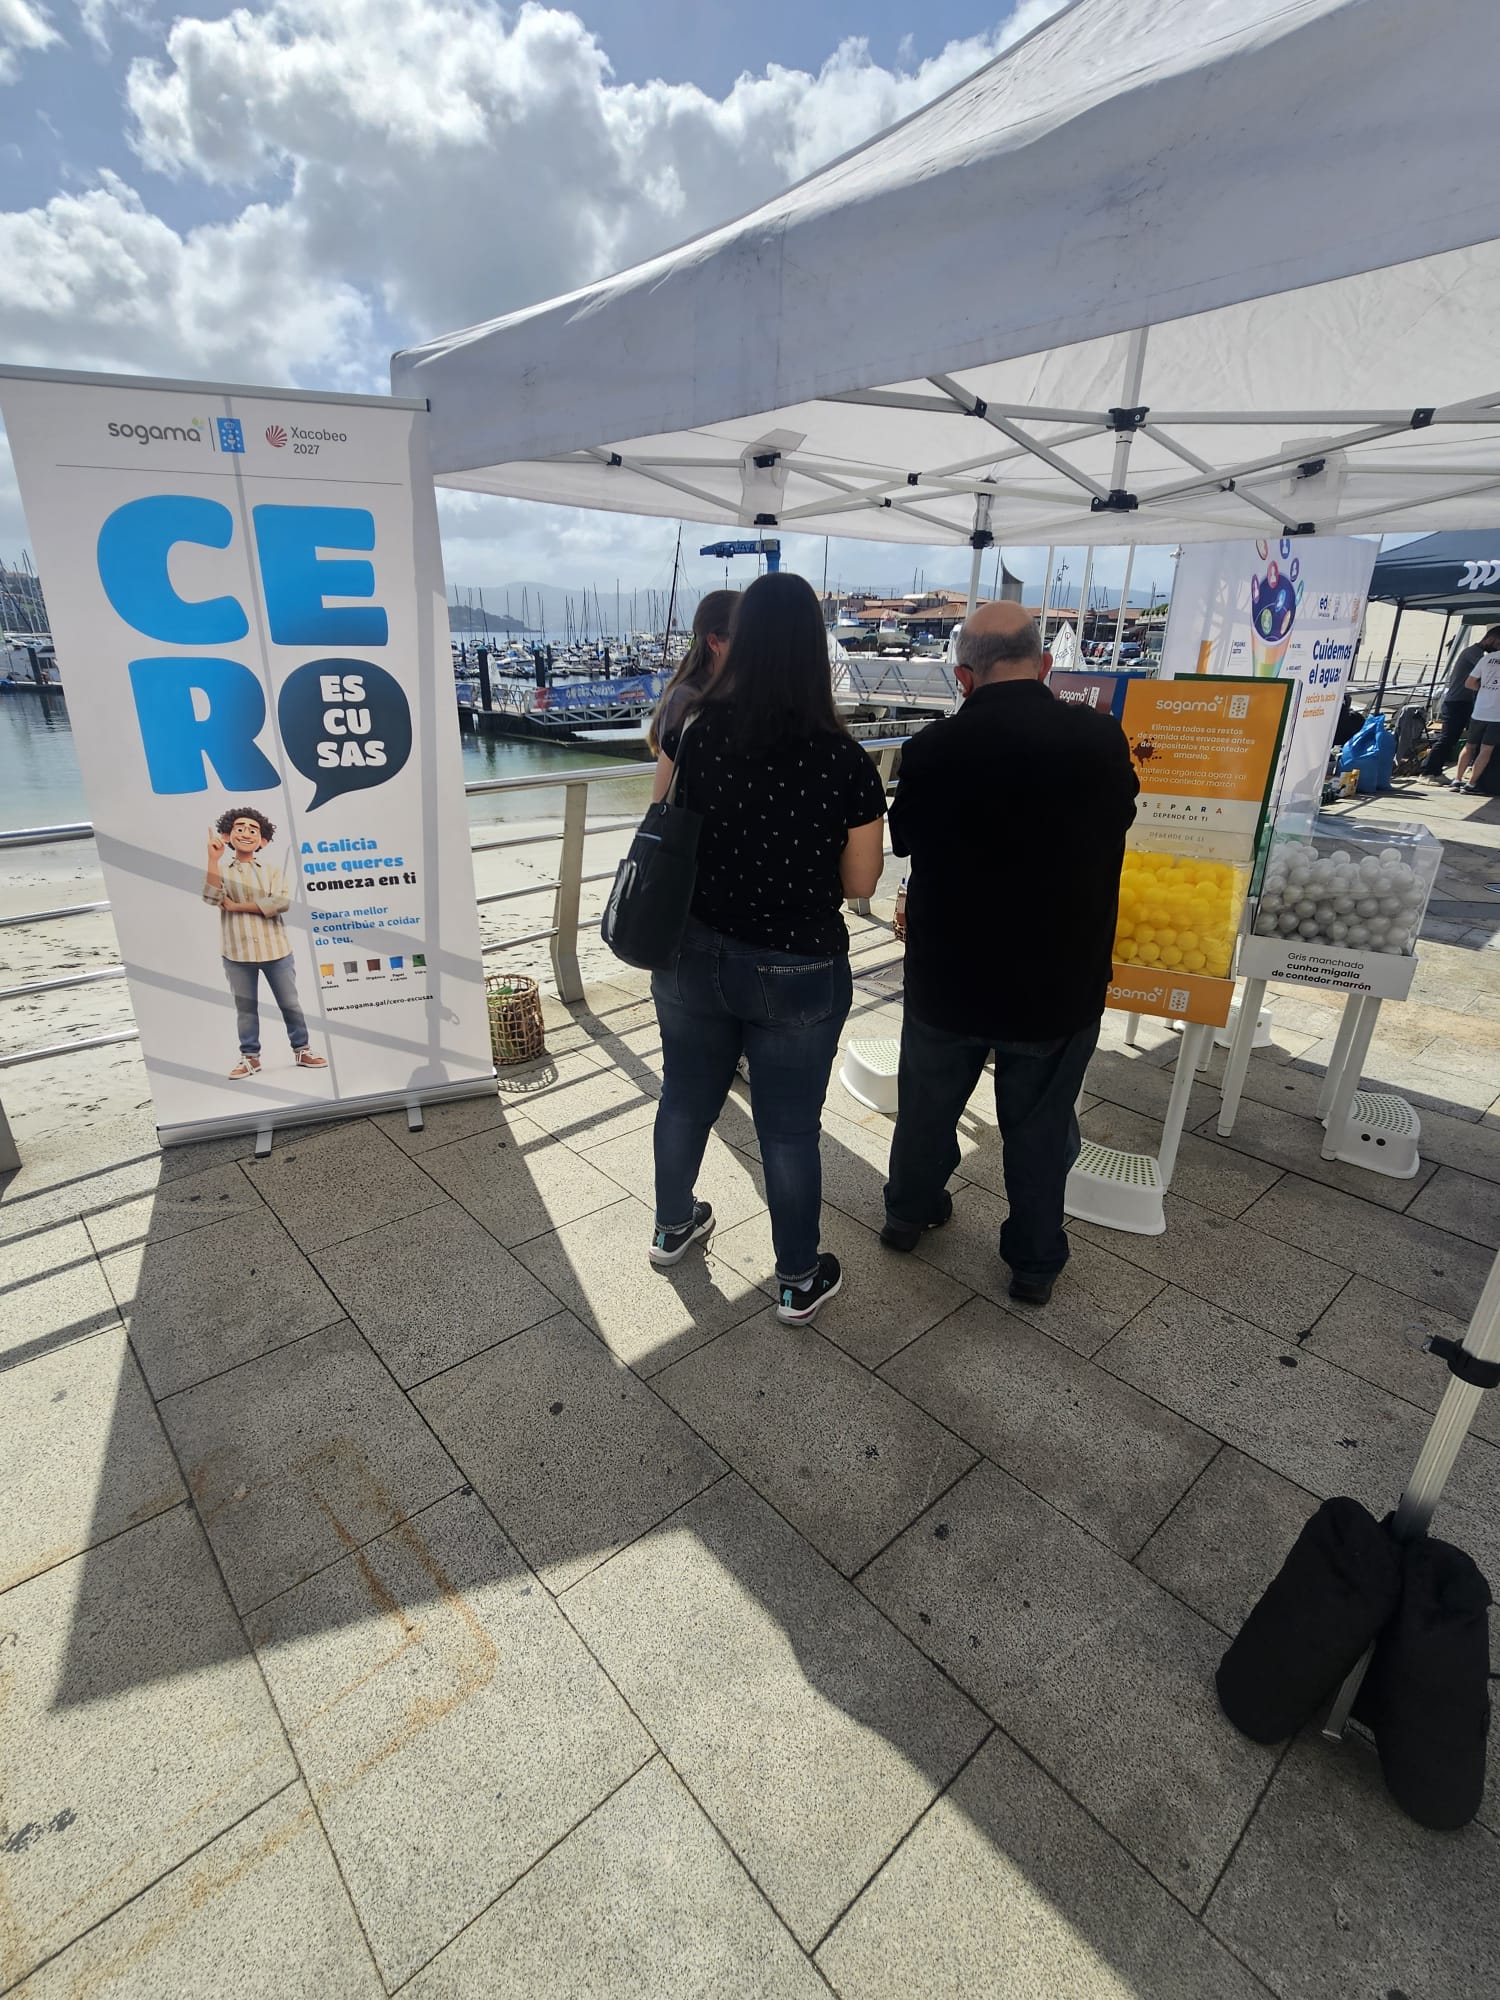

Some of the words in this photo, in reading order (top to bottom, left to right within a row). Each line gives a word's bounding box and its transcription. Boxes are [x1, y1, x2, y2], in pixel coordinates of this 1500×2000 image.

[107, 422, 201, 445] sogama
[290, 426, 347, 442] Xacobeo
[293, 443, 320, 455] 2027
[1313, 637, 1352, 661] Cuidemos
[1309, 663, 1319, 685] el
[319, 674, 366, 702] ES
[1059, 689, 1085, 703] sogama
[1155, 699, 1217, 714] sogama
[322, 707, 372, 735] CU
[1151, 723, 1181, 732] Elimina
[1182, 725, 1204, 733] todos
[1217, 727, 1243, 735] restos
[1148, 732, 1178, 741] comida
[1180, 734, 1194, 742] dos
[1195, 736, 1230, 744] envases
[1231, 737, 1255, 745] antes
[316, 740, 388, 768] SAS
[1151, 742, 1198, 752] depositalos
[1211, 745, 1248, 753] contedor
[1170, 777, 1204, 787] contedor
[1207, 771, 1232, 780] agora
[1152, 812, 1186, 820] DEPENDE
[301, 841, 314, 855] A
[317, 837, 378, 853] Galicia
[303, 860, 337, 875] que
[341, 856, 404, 873] queres
[306, 876, 375, 892] comeza
[378, 874, 400, 887] en
[403, 872, 417, 885] ti
[311, 910, 351, 922] Separa
[353, 906, 389, 918] mellor
[322, 919, 376, 933] contribúe
[378, 920, 385, 928] a
[387, 916, 421, 926] coidar
[315, 937, 330, 946] do
[332, 934, 353, 945] teu.
[1287, 952, 1307, 962] Gris
[1308, 955, 1364, 970] manchado
[1286, 962, 1319, 973] cunha
[1320, 968, 1360, 979] migalla
[1271, 969, 1284, 978] de
[1285, 971, 1332, 984] contedor
[1332, 979, 1371, 991] marrón
[1107, 985, 1158, 1003] ogama
[326, 994, 434, 1012] www.sogama.gal/cero-escusas
